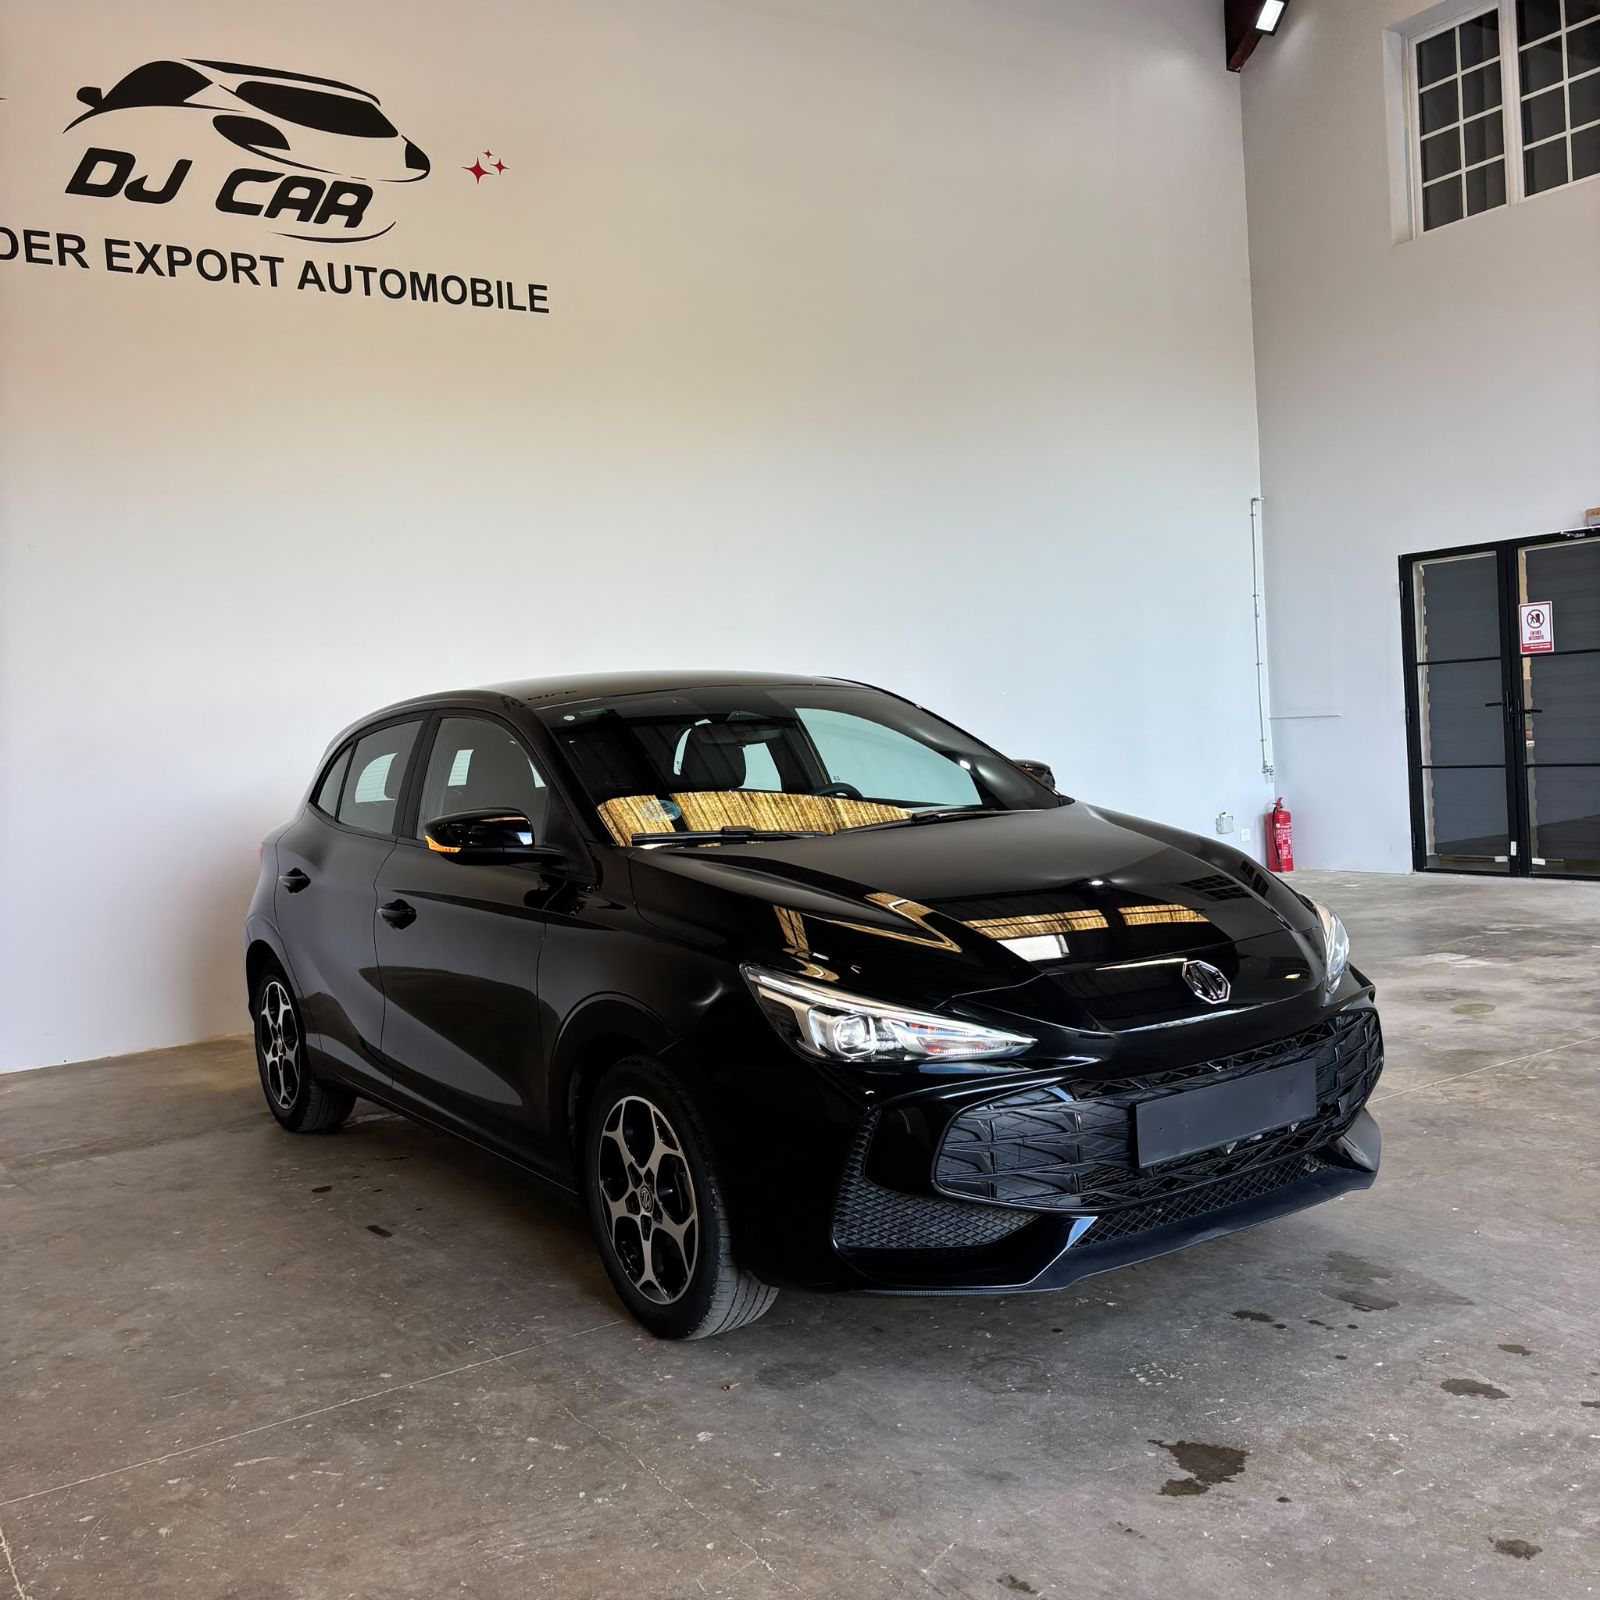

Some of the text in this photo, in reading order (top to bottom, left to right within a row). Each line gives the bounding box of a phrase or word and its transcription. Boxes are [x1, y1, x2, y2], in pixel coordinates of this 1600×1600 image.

[65, 147, 374, 228] DJ CAR
[104, 237, 284, 288] EXPORT
[297, 260, 550, 313] AUTOMOBILE
